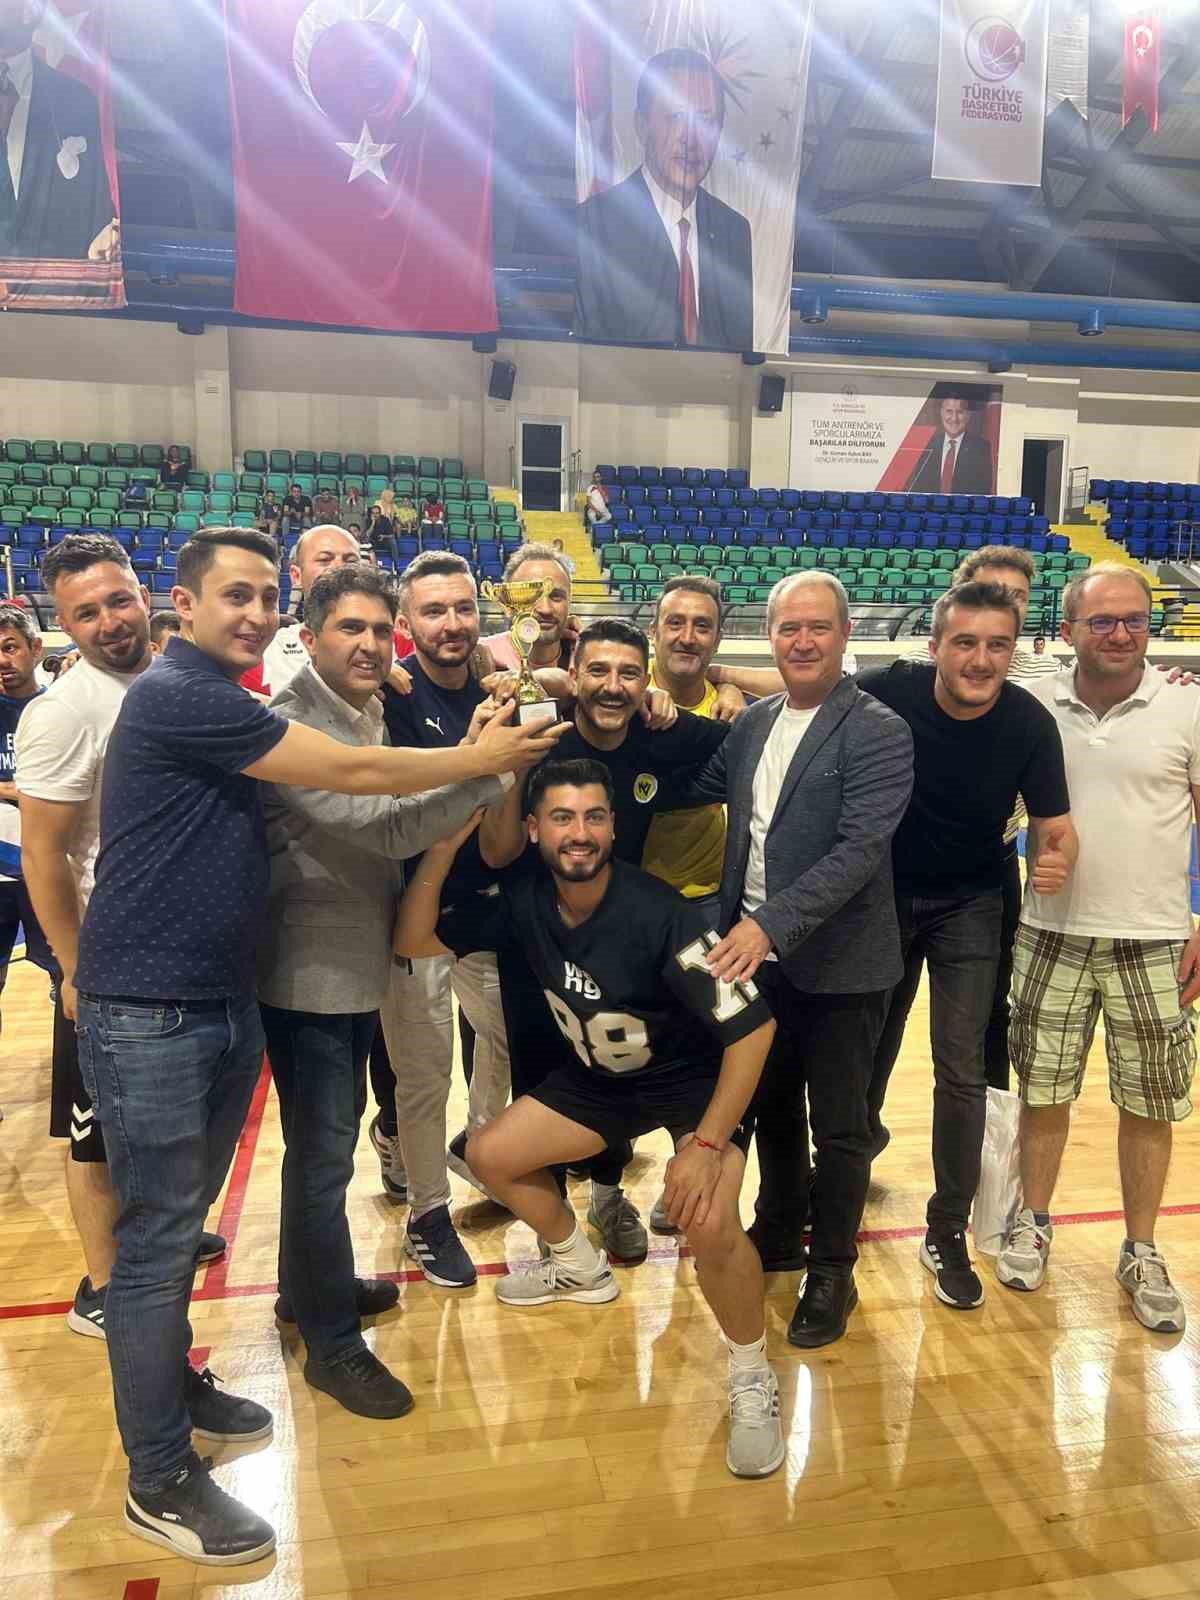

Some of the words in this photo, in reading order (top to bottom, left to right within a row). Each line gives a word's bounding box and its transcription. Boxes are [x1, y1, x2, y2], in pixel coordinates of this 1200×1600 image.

[961, 83, 1024, 103] TÜRKİYE
[962, 99, 1022, 114] BASKETBOL
[961, 109, 1022, 122] FEDERASYONU
